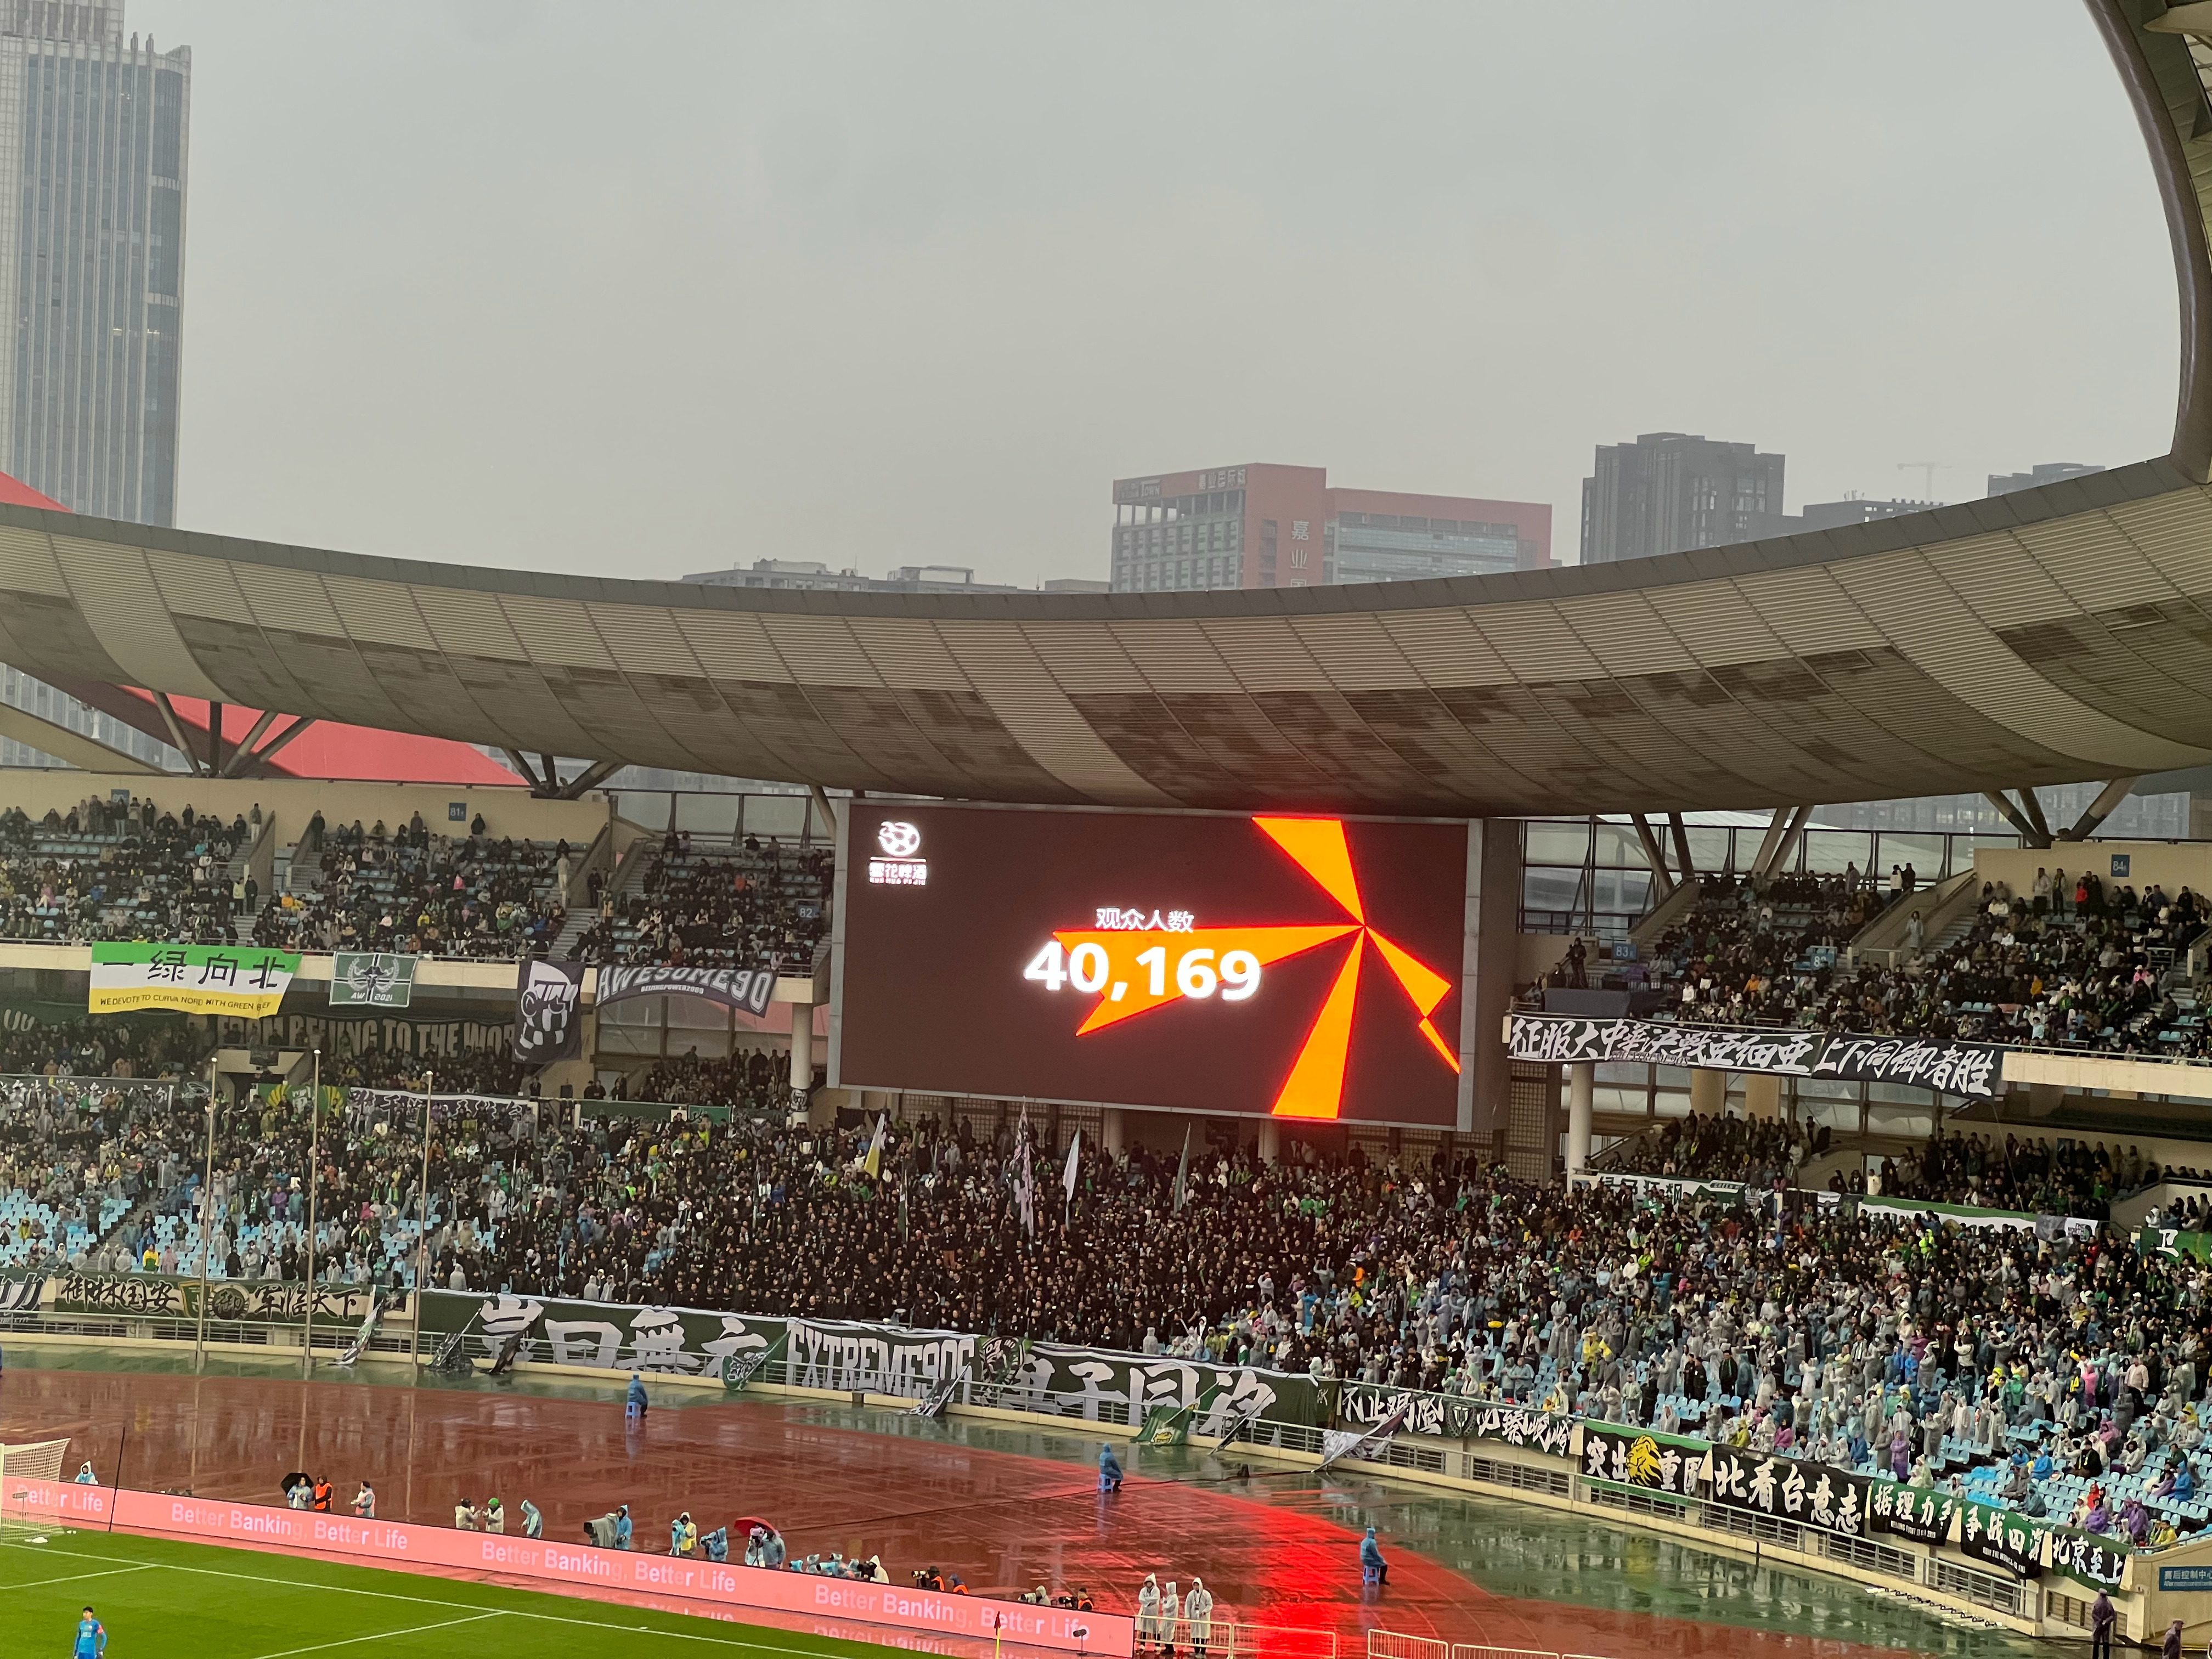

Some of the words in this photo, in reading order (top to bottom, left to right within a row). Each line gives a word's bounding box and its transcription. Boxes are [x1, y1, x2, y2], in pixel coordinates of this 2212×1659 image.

[1096, 908, 1194, 933] 观众人数
[103, 950, 285, 989] 一绿向北
[596, 965, 773, 1013] AWESOME90
[1024, 940, 1261, 1001] 40,169
[181, 997, 204, 1006] NORD
[206, 998, 225, 1007] WITH
[228, 1001, 254, 1010] GREEN
[382, 1019, 411, 1057] TO
[416, 1023, 460, 1058] THE
[60, 1269, 180, 1316] 御林国安
[1586, 1435, 1630, 1483] 突出
[72, 1491, 103, 1512] Life
[1714, 1454, 1862, 1534] 北看台意志
[171, 1504, 222, 1527] Better
[314, 1520, 370, 1545] Better
[374, 1525, 408, 1551] Life
[482, 1541, 539, 1566] Better
[635, 1559, 694, 1587] Better
[699, 1568, 736, 1593] Life
[2052, 1533, 2124, 1585] 北京至上
[815, 1583, 877, 1612] Better
[980, 1606, 1045, 1635] Better
[1051, 1615, 1090, 1640] Life
